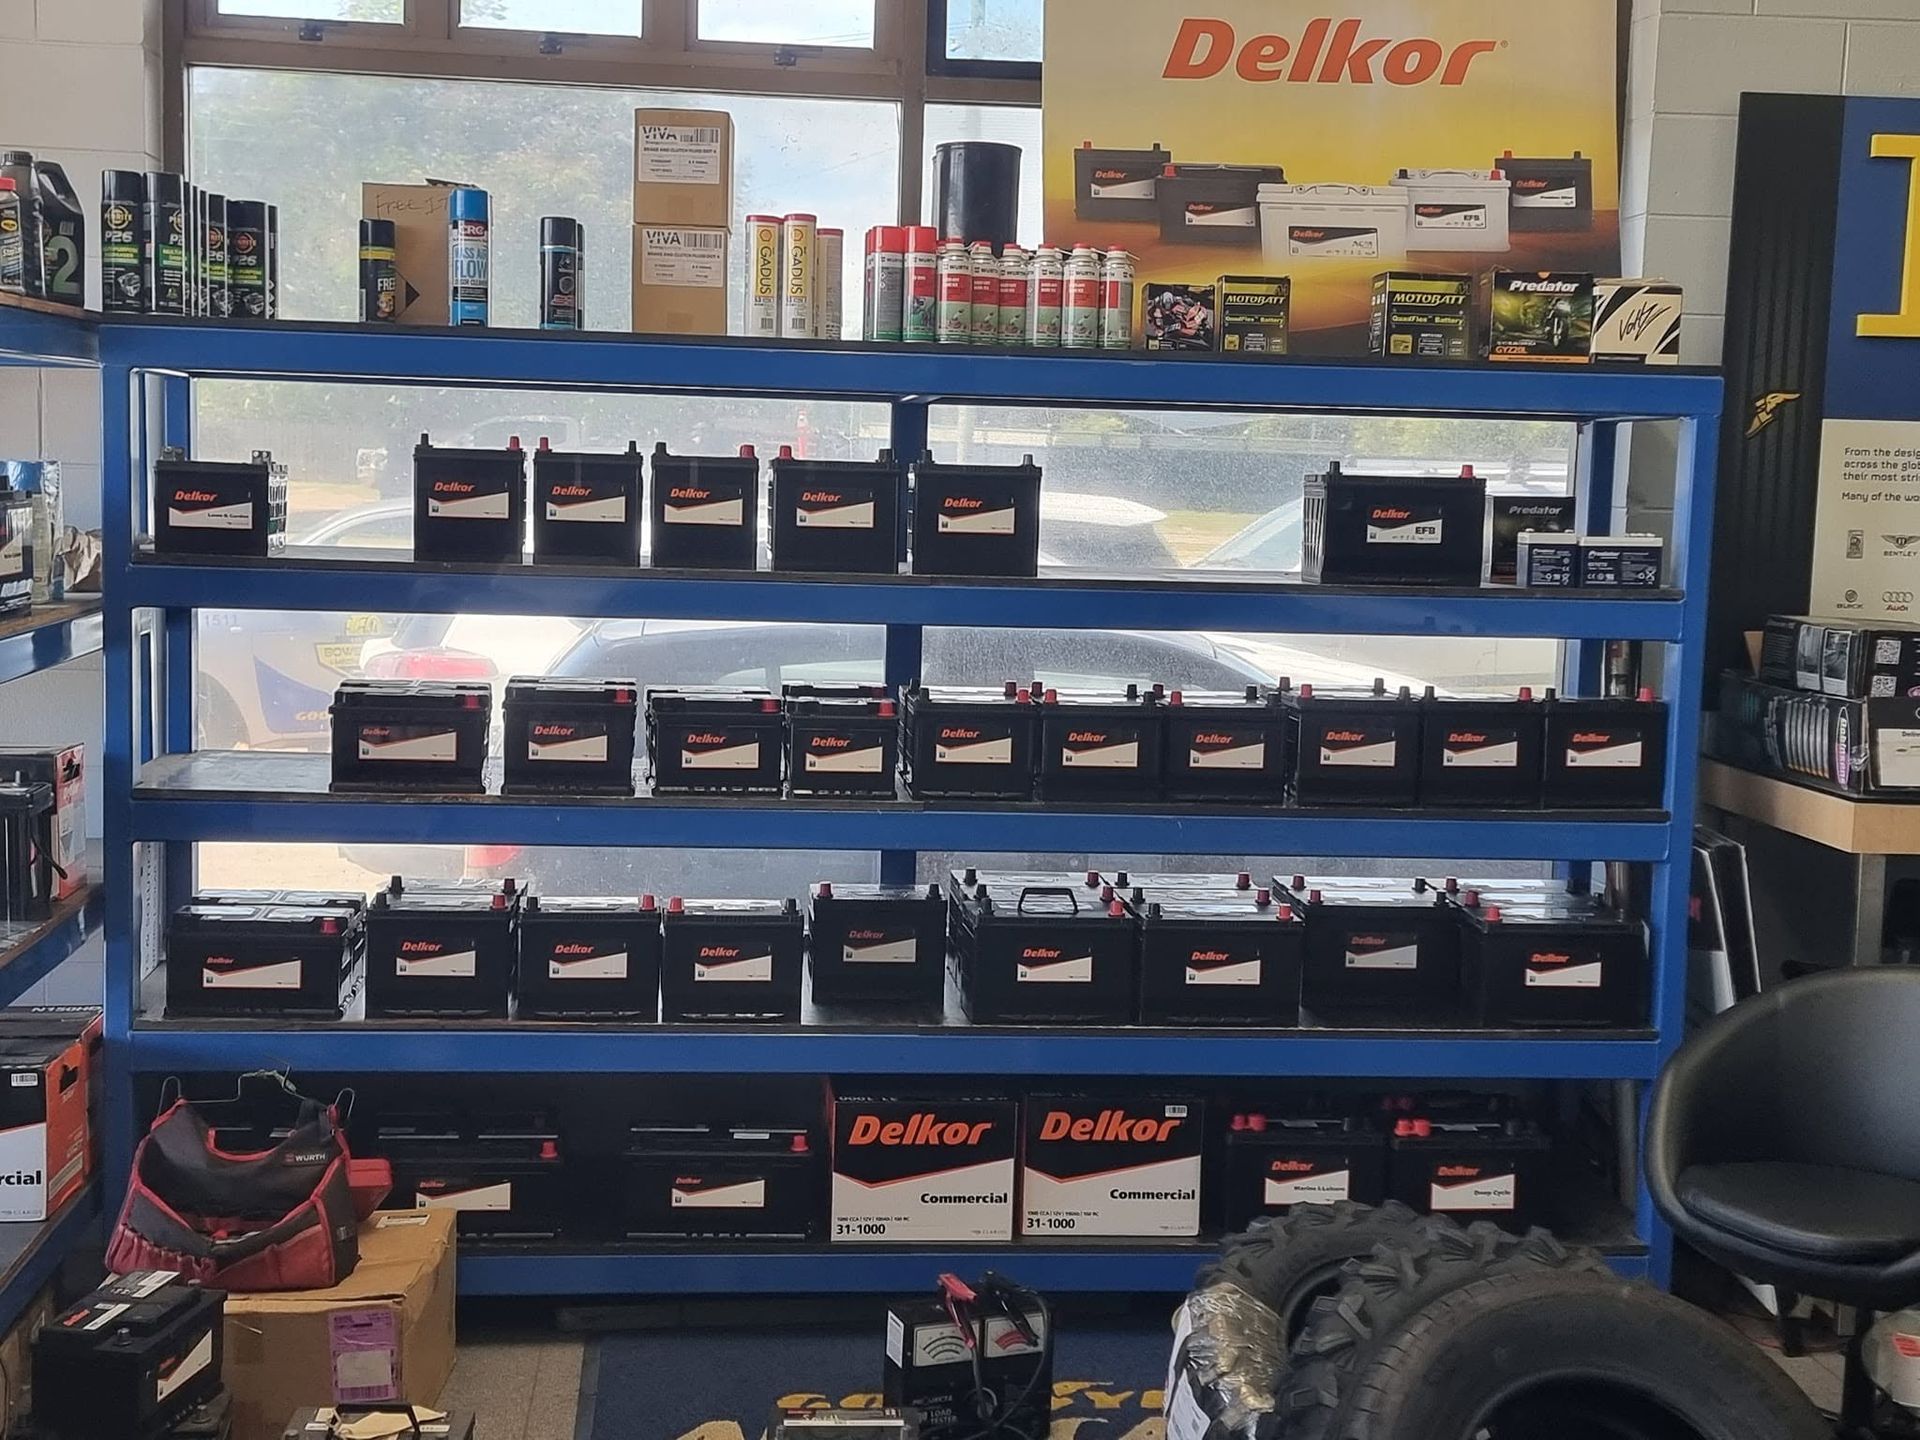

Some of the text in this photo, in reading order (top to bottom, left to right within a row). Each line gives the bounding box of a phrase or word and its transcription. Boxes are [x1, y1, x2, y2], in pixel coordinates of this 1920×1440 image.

[1162, 17, 1497, 87] Delkor
[642, 127, 677, 140] VIVA
[1094, 169, 1127, 180] Delkor
[646, 230, 681, 245] VIVA
[760, 245, 773, 295] GADUS
[790, 245, 804, 295] GADUS
[1509, 280, 1580, 293] Predator
[1225, 294, 1286, 305] MOTOBATT
[1392, 292, 1466, 306] MOTOBATT
[1844, 447, 1871, 457] From
[1873, 447, 1891, 457] the
[1843, 460, 1878, 470] across
[1881, 460, 1899, 470] the
[1842, 471, 1869, 481] their
[1870, 473, 1898, 482] most
[434, 482, 475, 493] Delkor
[552, 486, 592, 497] Delkor
[671, 487, 712, 499] Delkor
[175, 491, 218, 502] Delkor
[802, 491, 843, 503] Delkor
[1841, 491, 1869, 503] Many
[1870, 491, 1883, 501] of
[1884, 492, 1901, 502] the
[943, 497, 984, 509] Delkor
[1372, 509, 1411, 519] Delkor
[1508, 505, 1563, 516] Predator
[1414, 526, 1436, 535] EFB
[1886, 604, 1909, 612] Audi
[535, 725, 573, 736] Delkor
[942, 728, 979, 739] Delkor
[687, 734, 726, 744] Delkor
[1068, 731, 1106, 743] Delkor
[1195, 733, 1233, 745] Delkor
[1326, 731, 1365, 742] Delkor
[812, 737, 850, 748] Delkor
[848, 930, 884, 940] Delkor
[402, 941, 441, 952] Delkor
[555, 944, 595, 954] Delkor
[700, 947, 739, 957] Delkor
[1023, 948, 1060, 958] Delkor
[1191, 951, 1230, 961] Delkor
[848, 1112, 992, 1147] Delkor
[1039, 1108, 1181, 1143] Delkor
[920, 1192, 1008, 1204] Commercial
[1109, 1188, 1196, 1201] Commercial
[1026, 1217, 1076, 1229] 31-1000
[836, 1223, 886, 1235] 31-1000
[930, 1408, 952, 1418] LOAD
